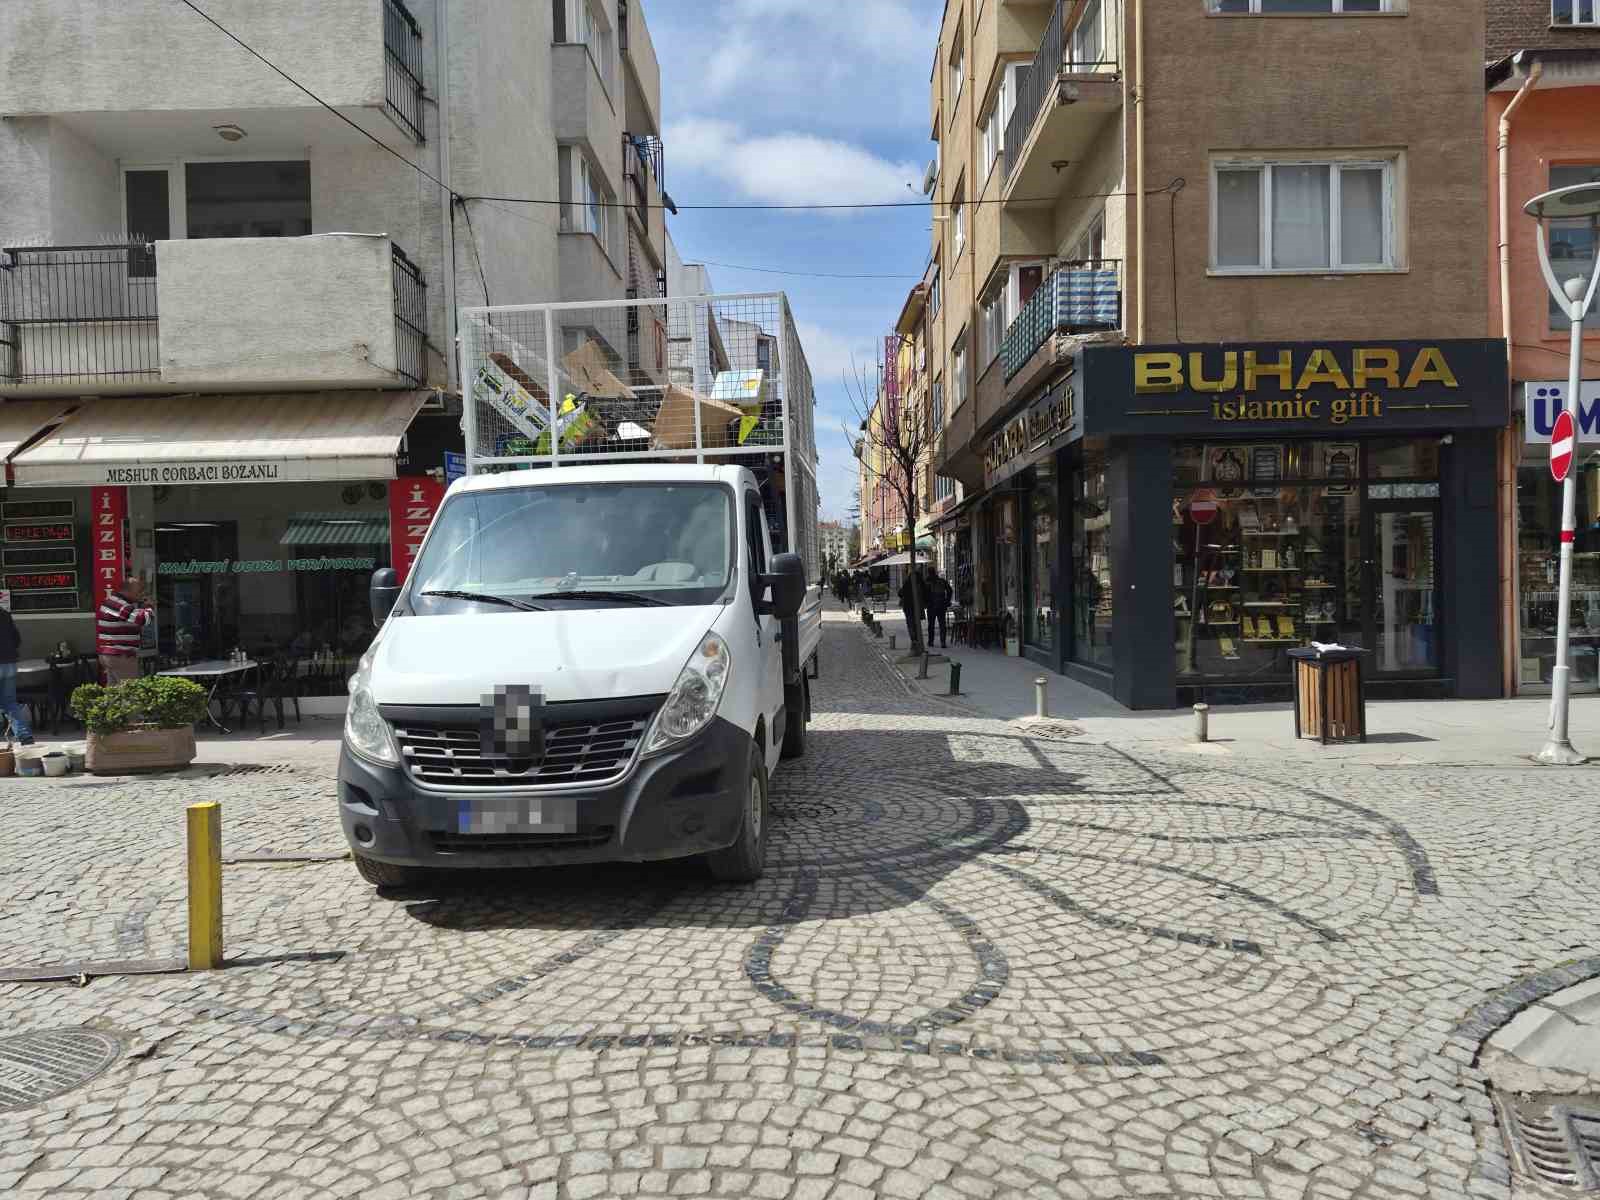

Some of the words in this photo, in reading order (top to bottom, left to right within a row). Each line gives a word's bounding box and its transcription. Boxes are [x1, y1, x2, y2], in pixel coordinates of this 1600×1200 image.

[1134, 347, 1459, 393] BUHARA
[1212, 394, 1320, 421] islamic
[1331, 391, 1384, 424] gift
[222, 464, 279, 480] BOZANLI
[404, 484, 432, 570] İZZE
